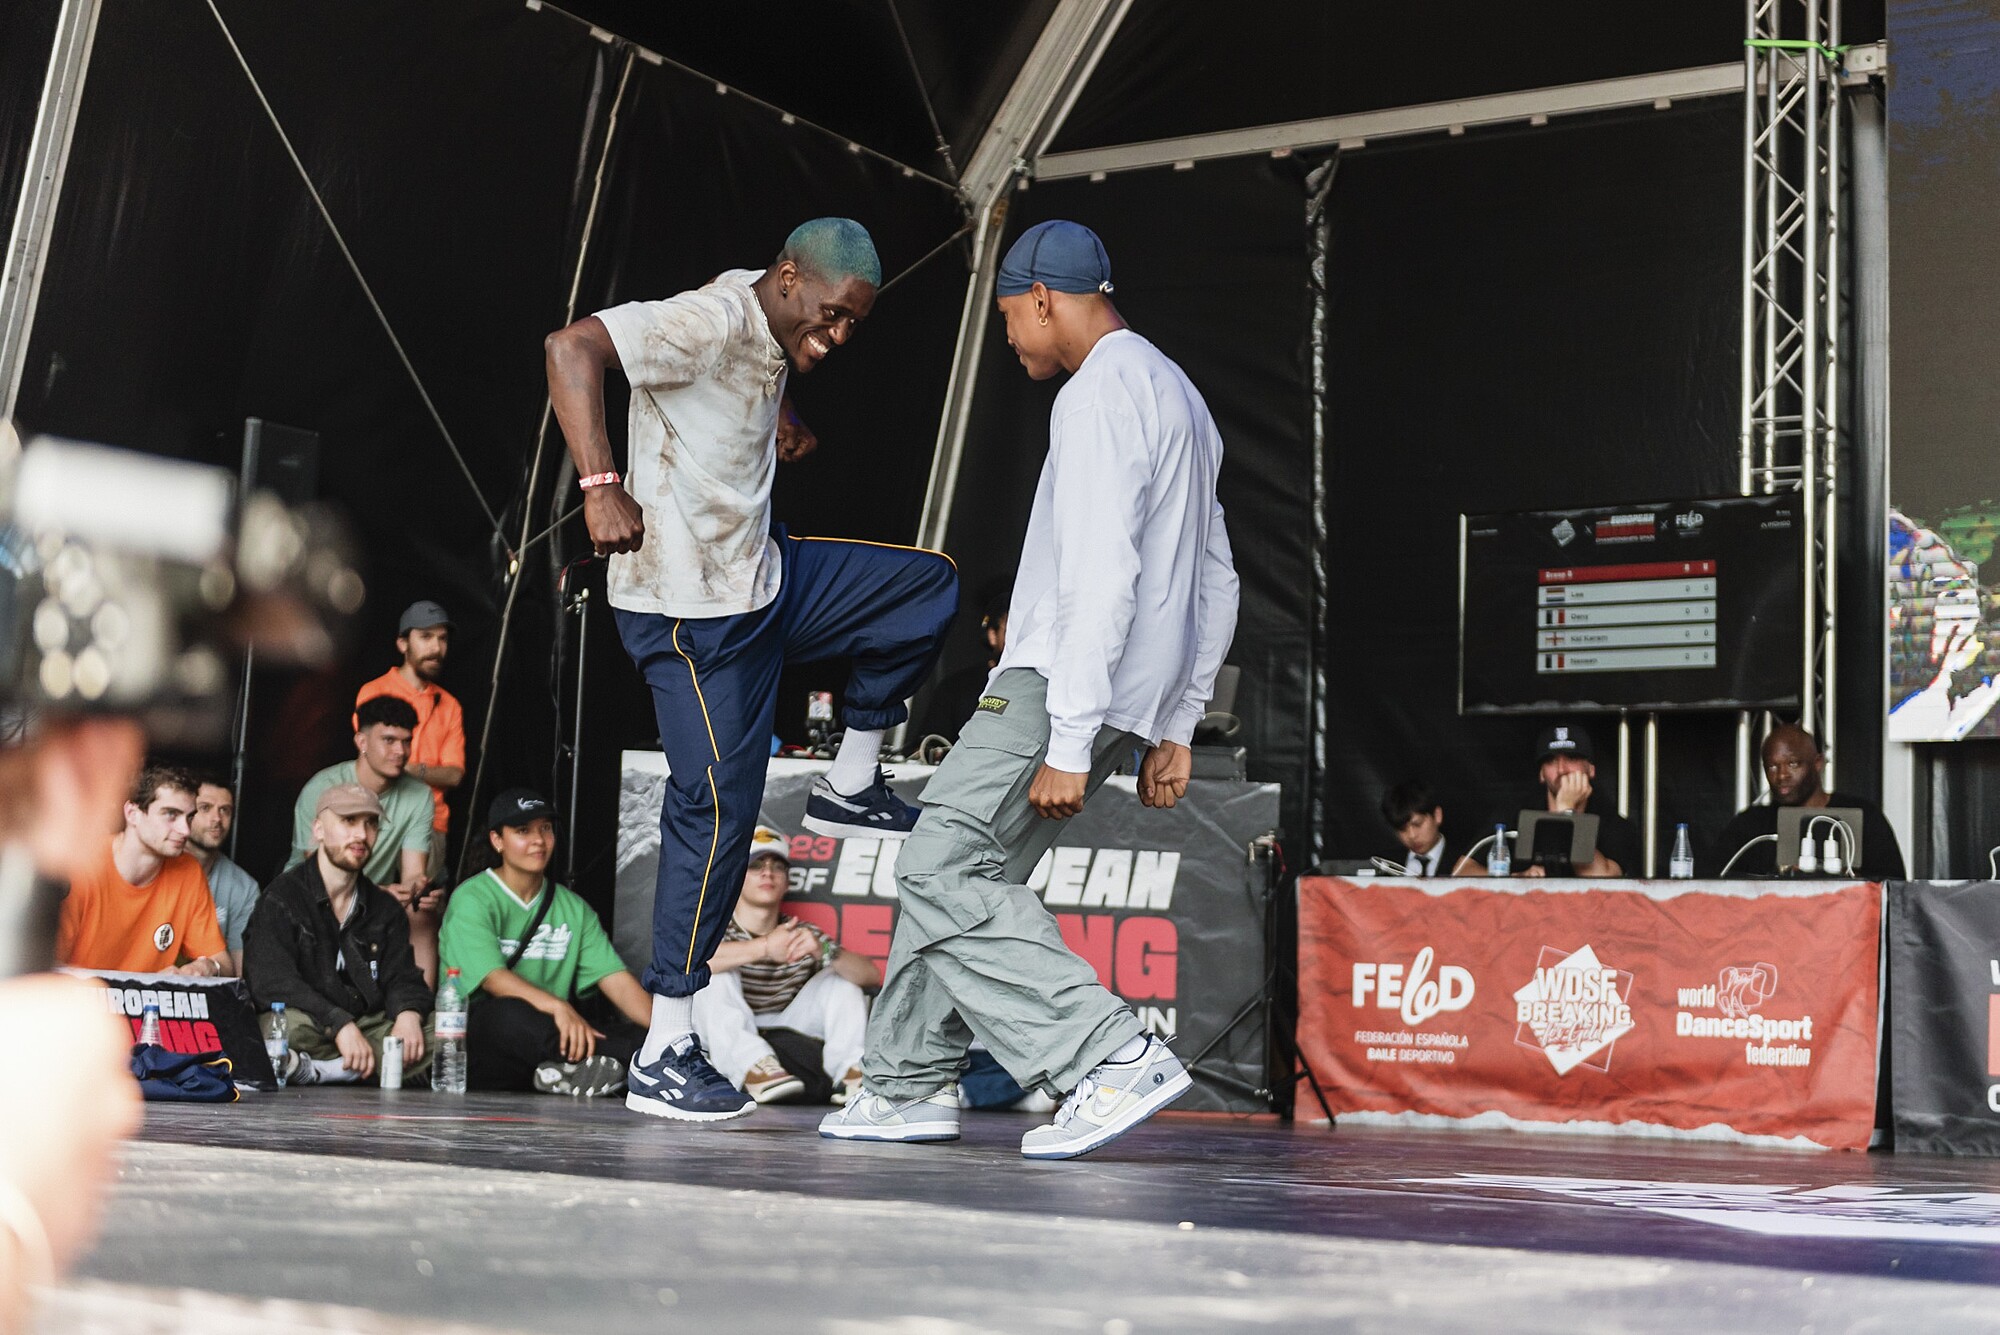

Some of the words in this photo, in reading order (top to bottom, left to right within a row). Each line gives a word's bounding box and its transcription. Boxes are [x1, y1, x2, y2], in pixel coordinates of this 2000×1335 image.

[1537, 967, 1618, 1003] WDSF
[1677, 984, 1716, 1008] world
[1516, 1001, 1631, 1026] BREAKING
[1354, 1029, 1414, 1045] FEDERACIÓN
[1415, 1032, 1469, 1048] ESPAÑOLA
[1676, 1012, 1813, 1044] DanceSport
[1366, 1047, 1397, 1061] BAILE
[1398, 1048, 1455, 1064] DEPORTIVO
[1745, 1042, 1811, 1067] federation
